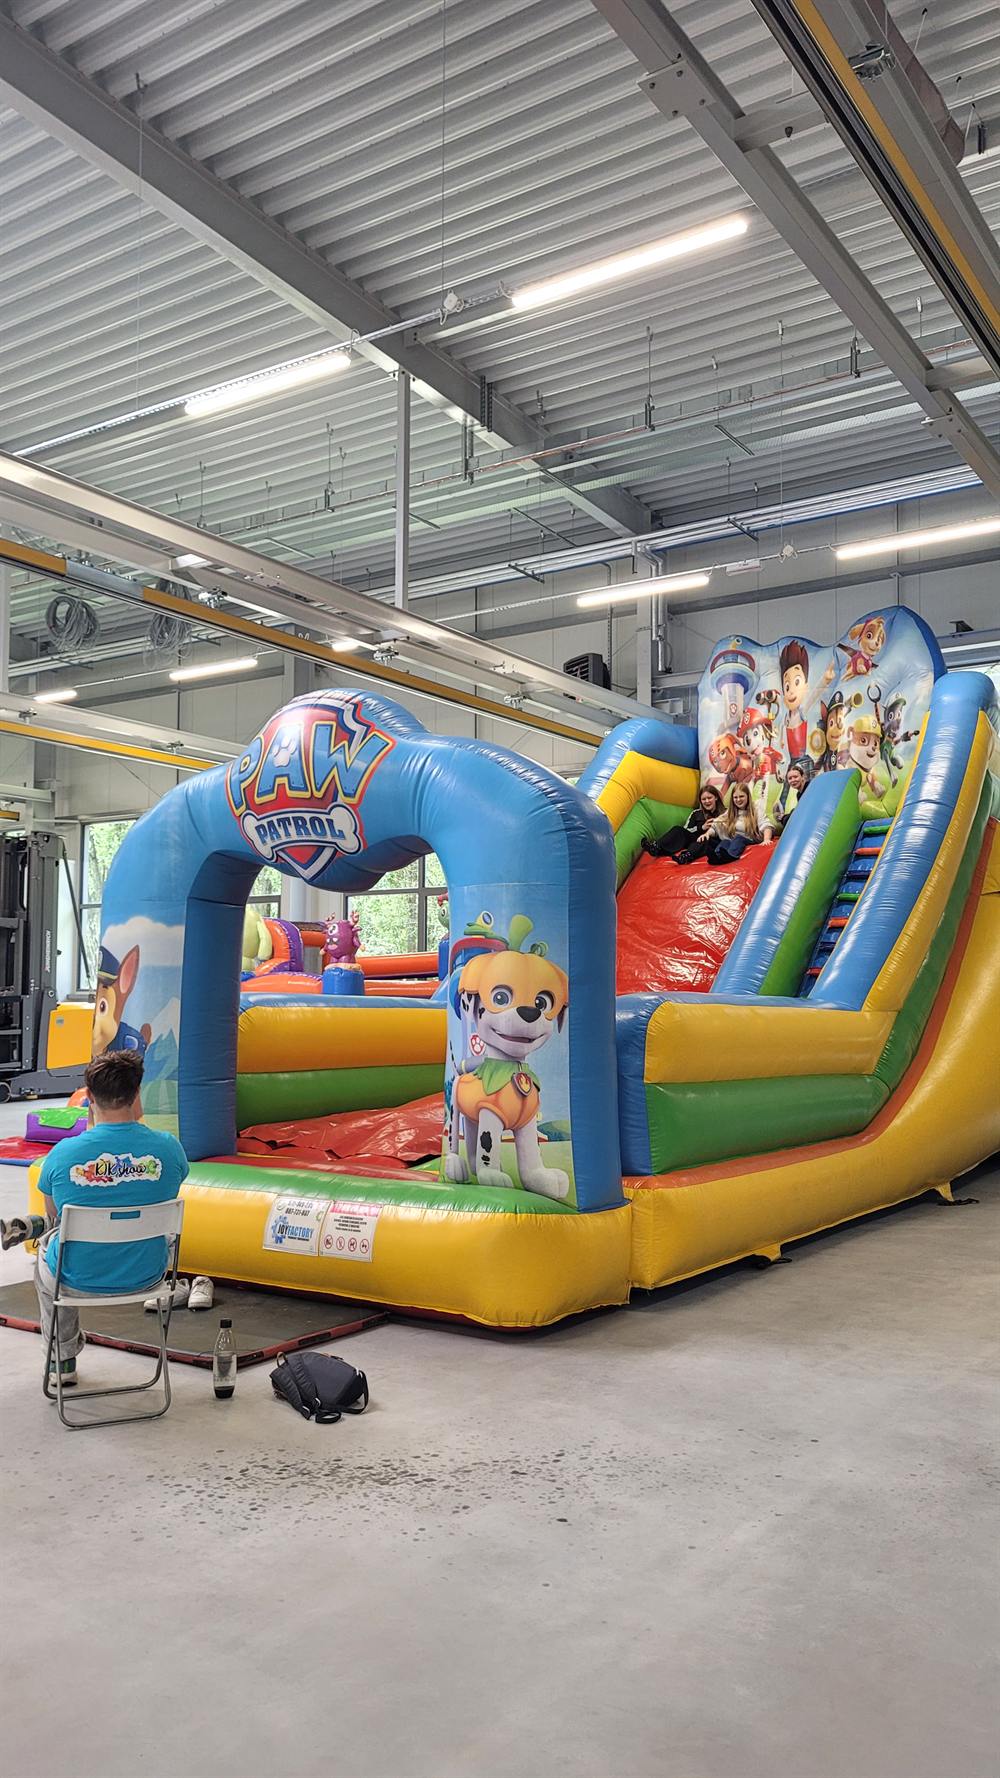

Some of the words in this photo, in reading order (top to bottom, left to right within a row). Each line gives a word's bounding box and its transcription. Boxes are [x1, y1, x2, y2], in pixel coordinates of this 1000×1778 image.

[228, 721, 394, 816] PAW
[255, 815, 346, 846] PATROL
[277, 1223, 314, 1239] JOYFACTORY
